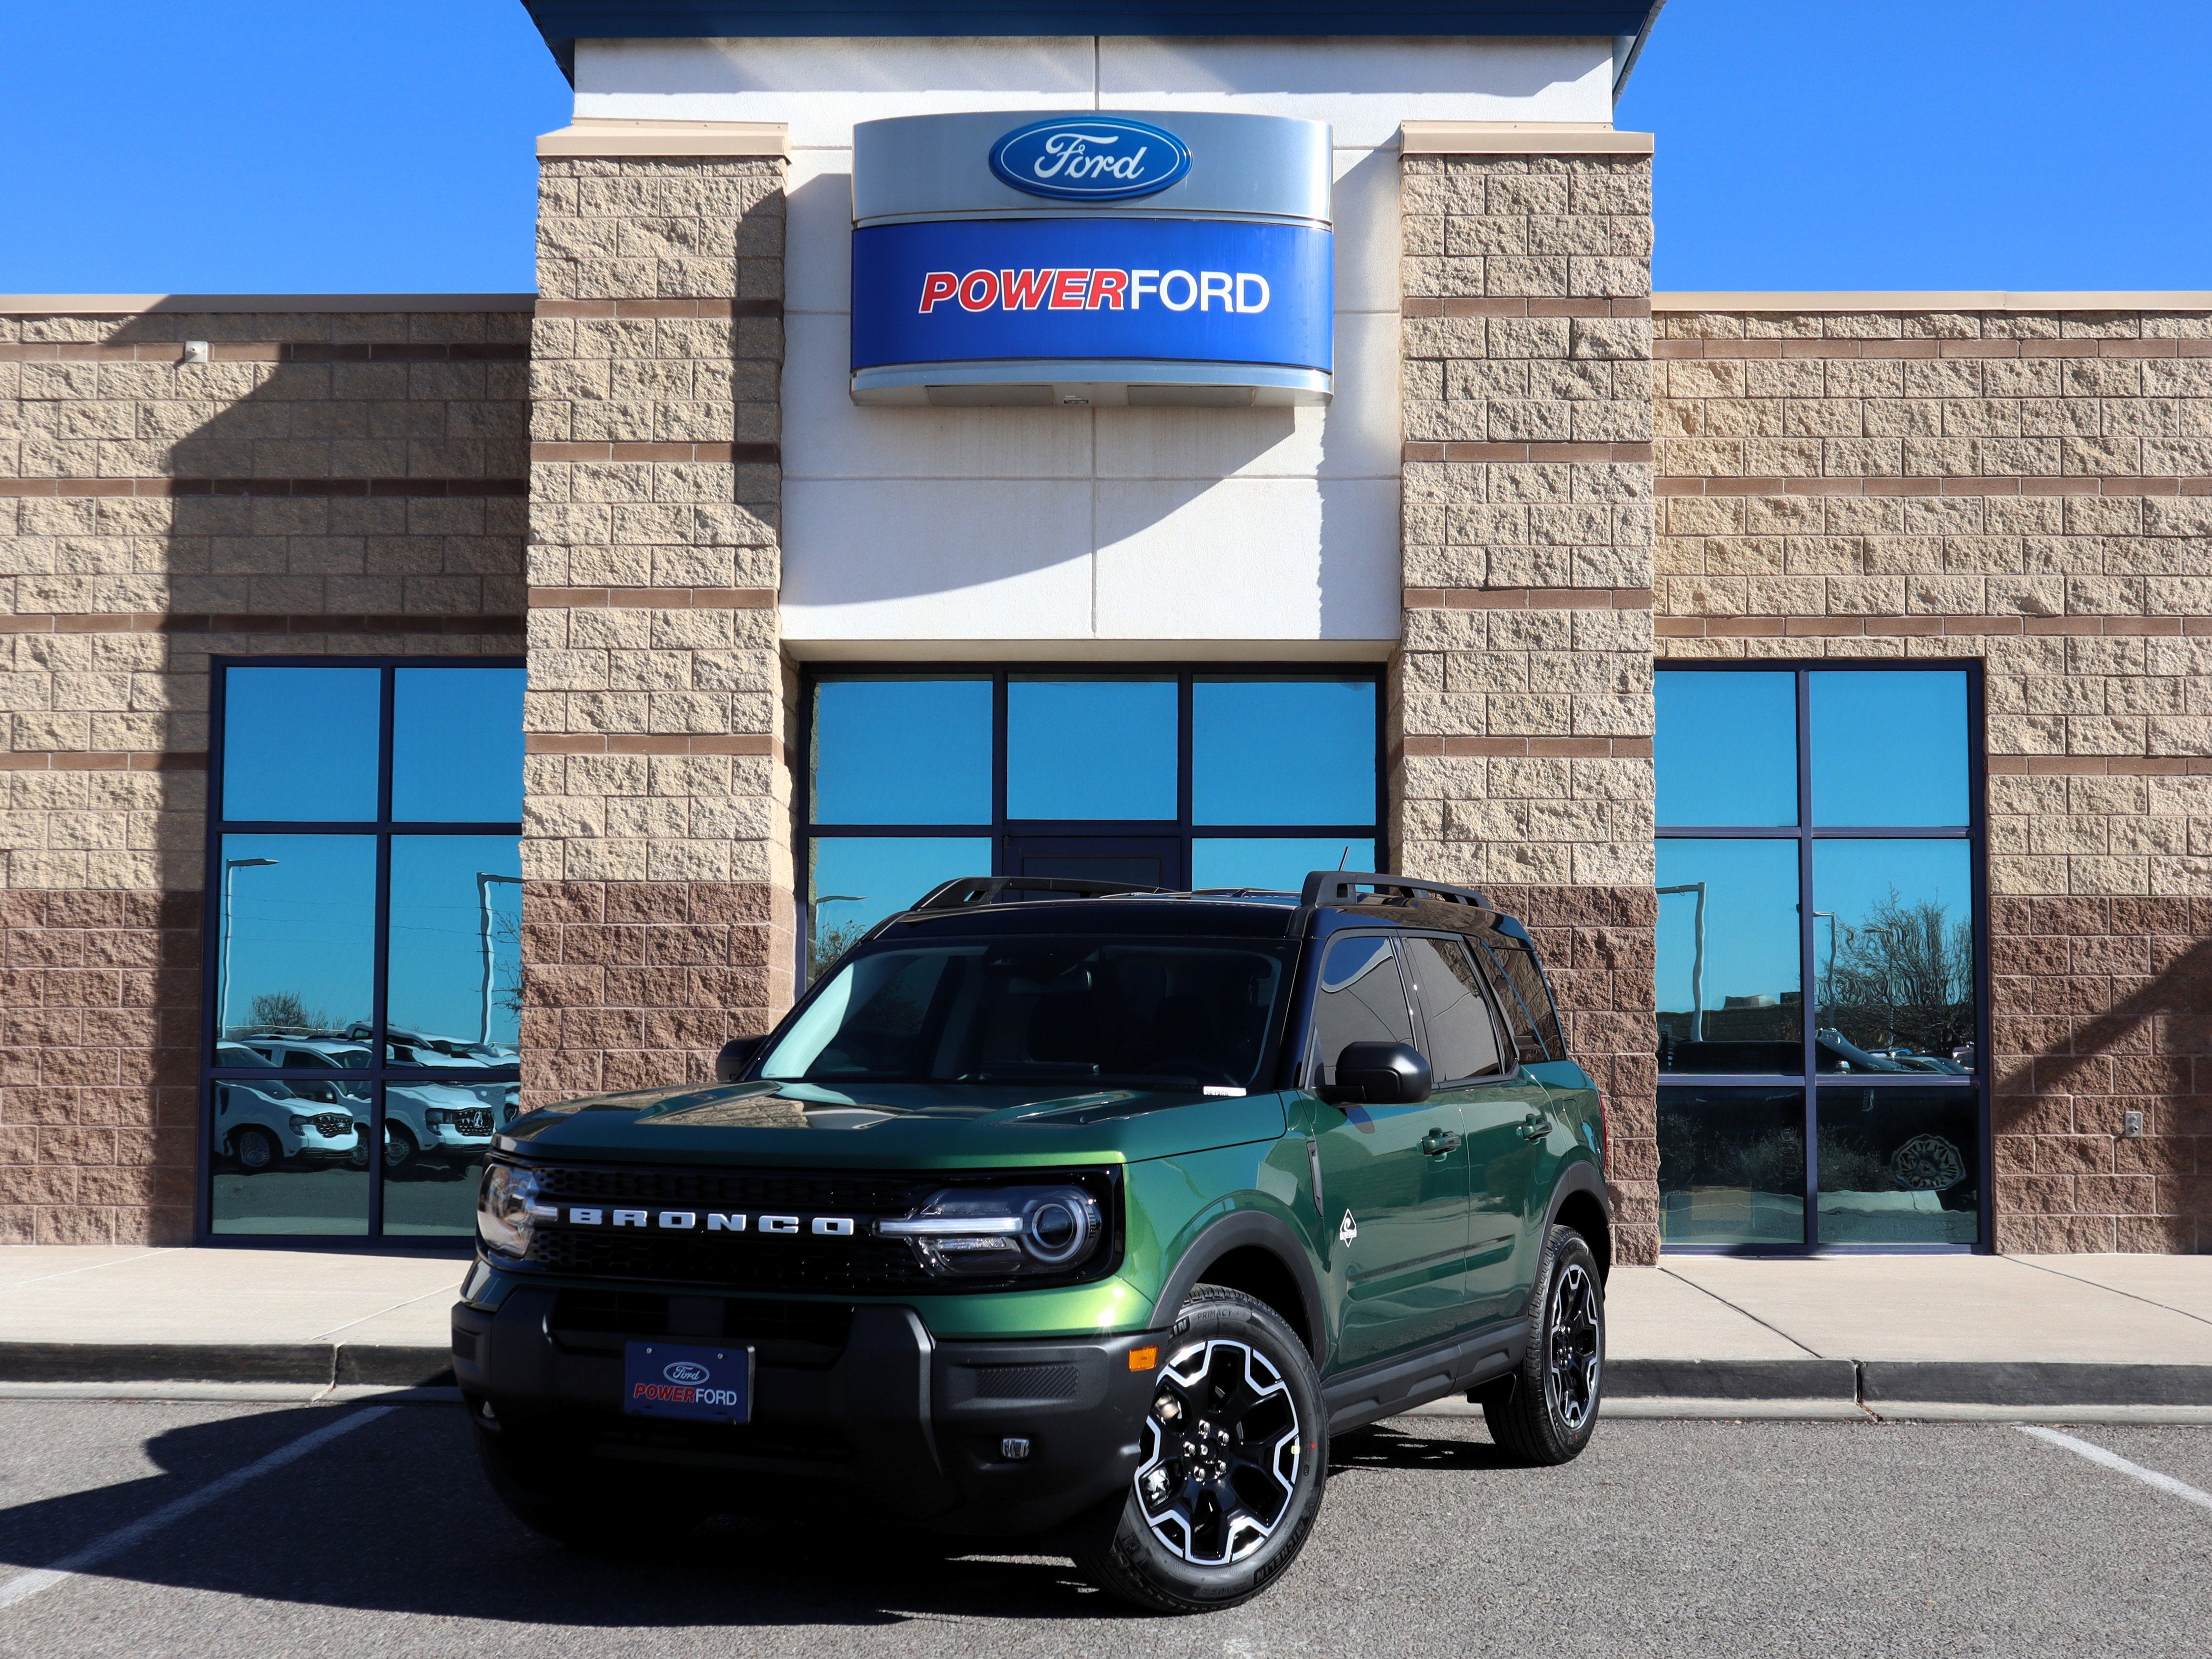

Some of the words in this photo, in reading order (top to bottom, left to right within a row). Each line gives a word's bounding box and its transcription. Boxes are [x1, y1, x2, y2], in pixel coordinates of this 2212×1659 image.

[1034, 133, 1148, 179] Ford
[569, 1207, 854, 1235] BRONCO
[1197, 1309, 1232, 1320] PRIMACY
[673, 1366, 701, 1381] Ford
[1256, 1520, 1306, 1582] MICHELIN
